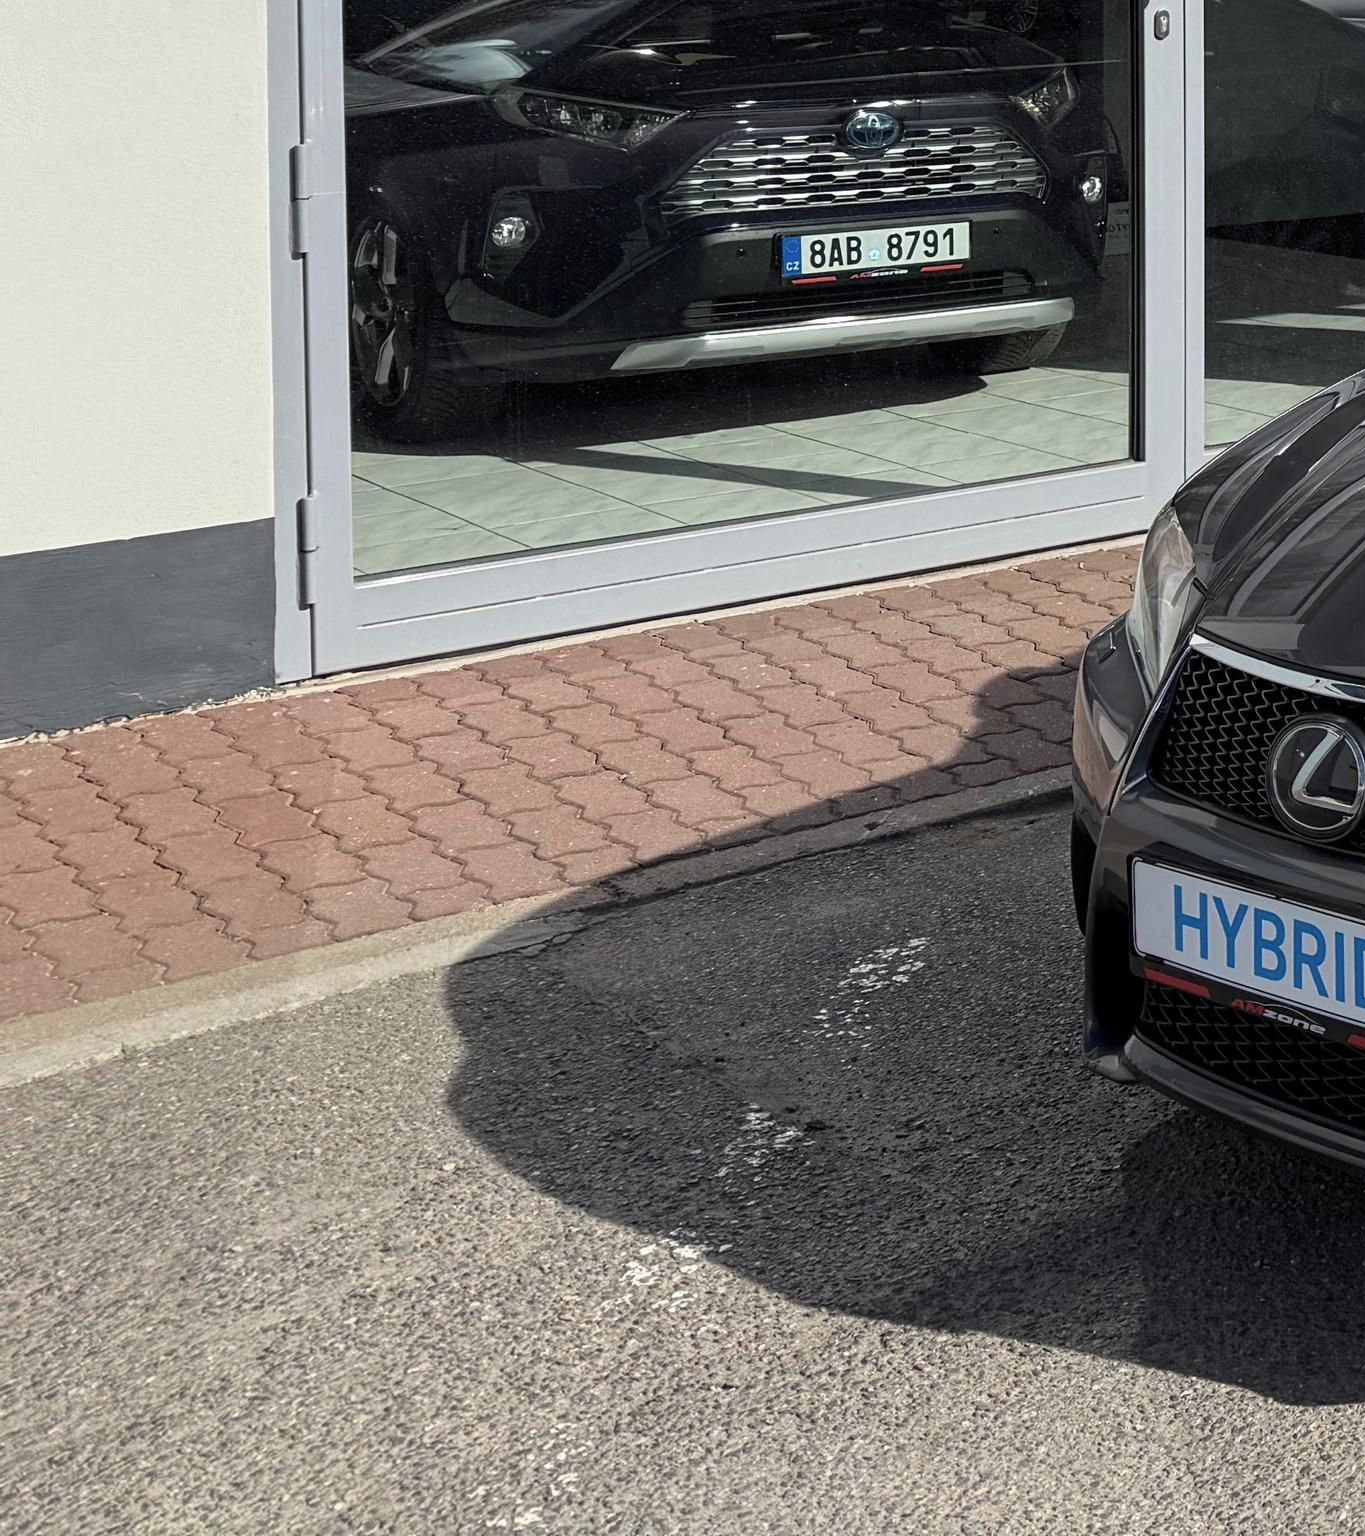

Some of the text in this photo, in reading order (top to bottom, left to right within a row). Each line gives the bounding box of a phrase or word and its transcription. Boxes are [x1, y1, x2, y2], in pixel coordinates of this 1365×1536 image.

[786, 227, 954, 271] CZ 8AB 8791
[1230, 998, 1327, 1036] AMzone
